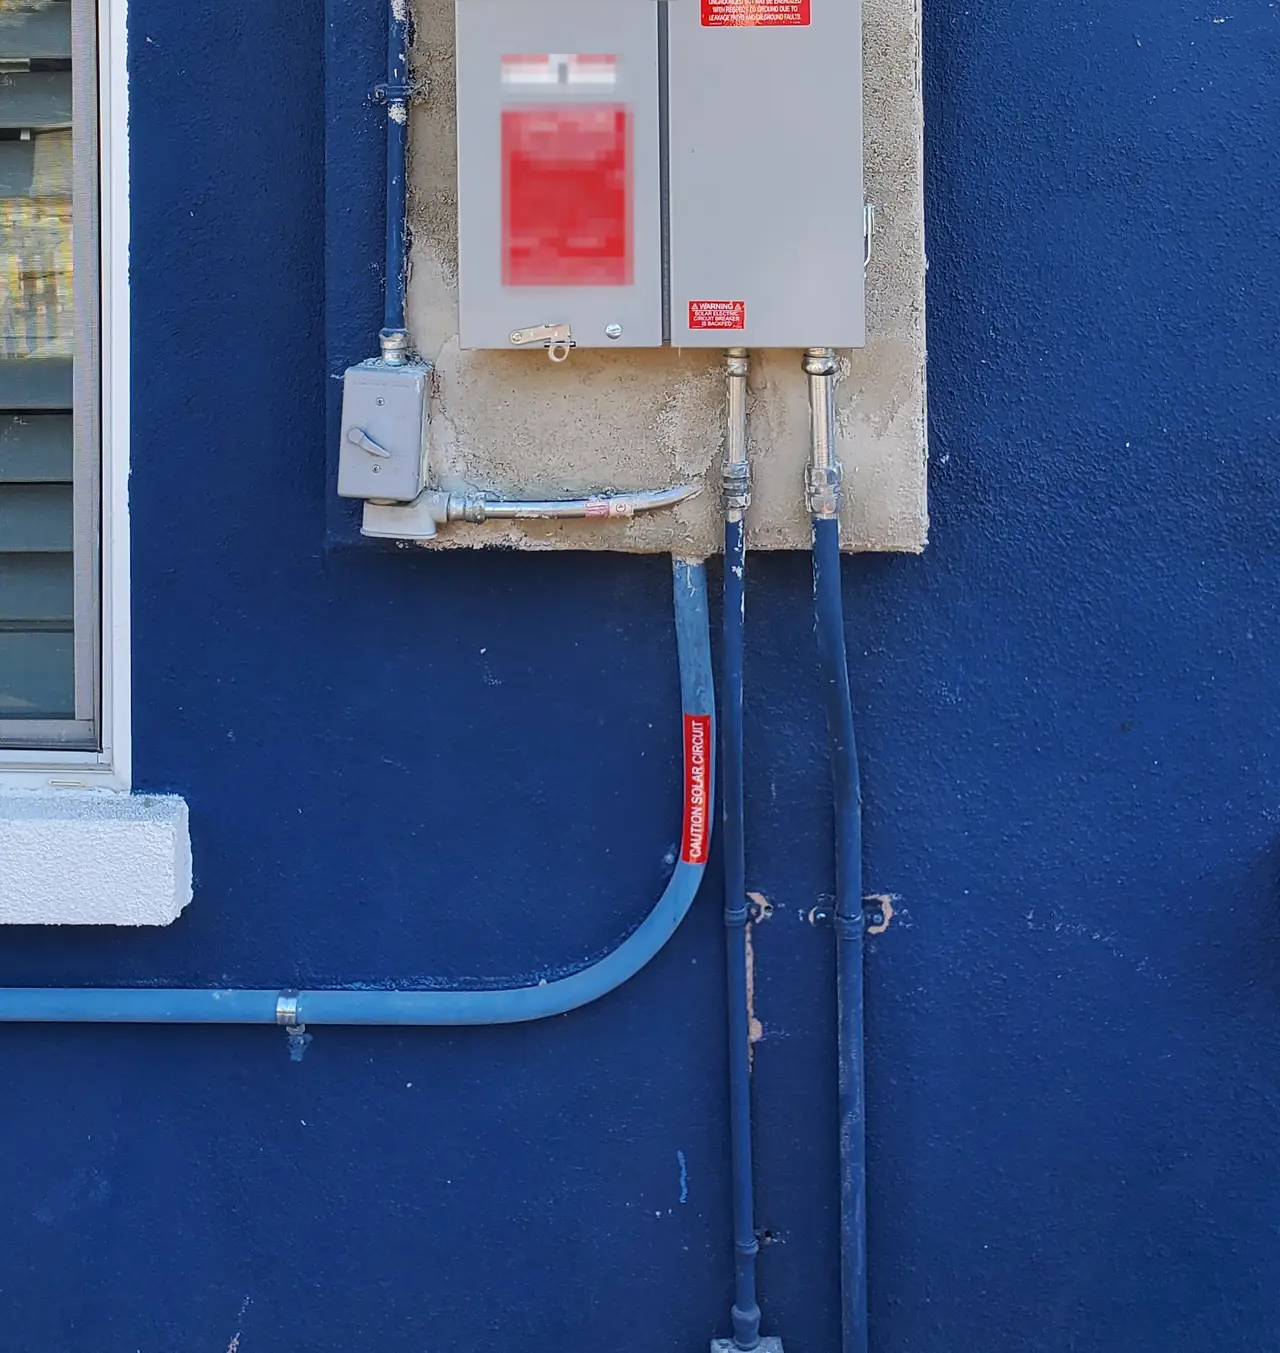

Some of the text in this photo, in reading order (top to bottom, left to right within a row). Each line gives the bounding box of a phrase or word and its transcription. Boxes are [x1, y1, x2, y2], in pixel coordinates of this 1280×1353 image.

[690, 720, 704, 857] CAUTION SOLAR CIRCUIT
